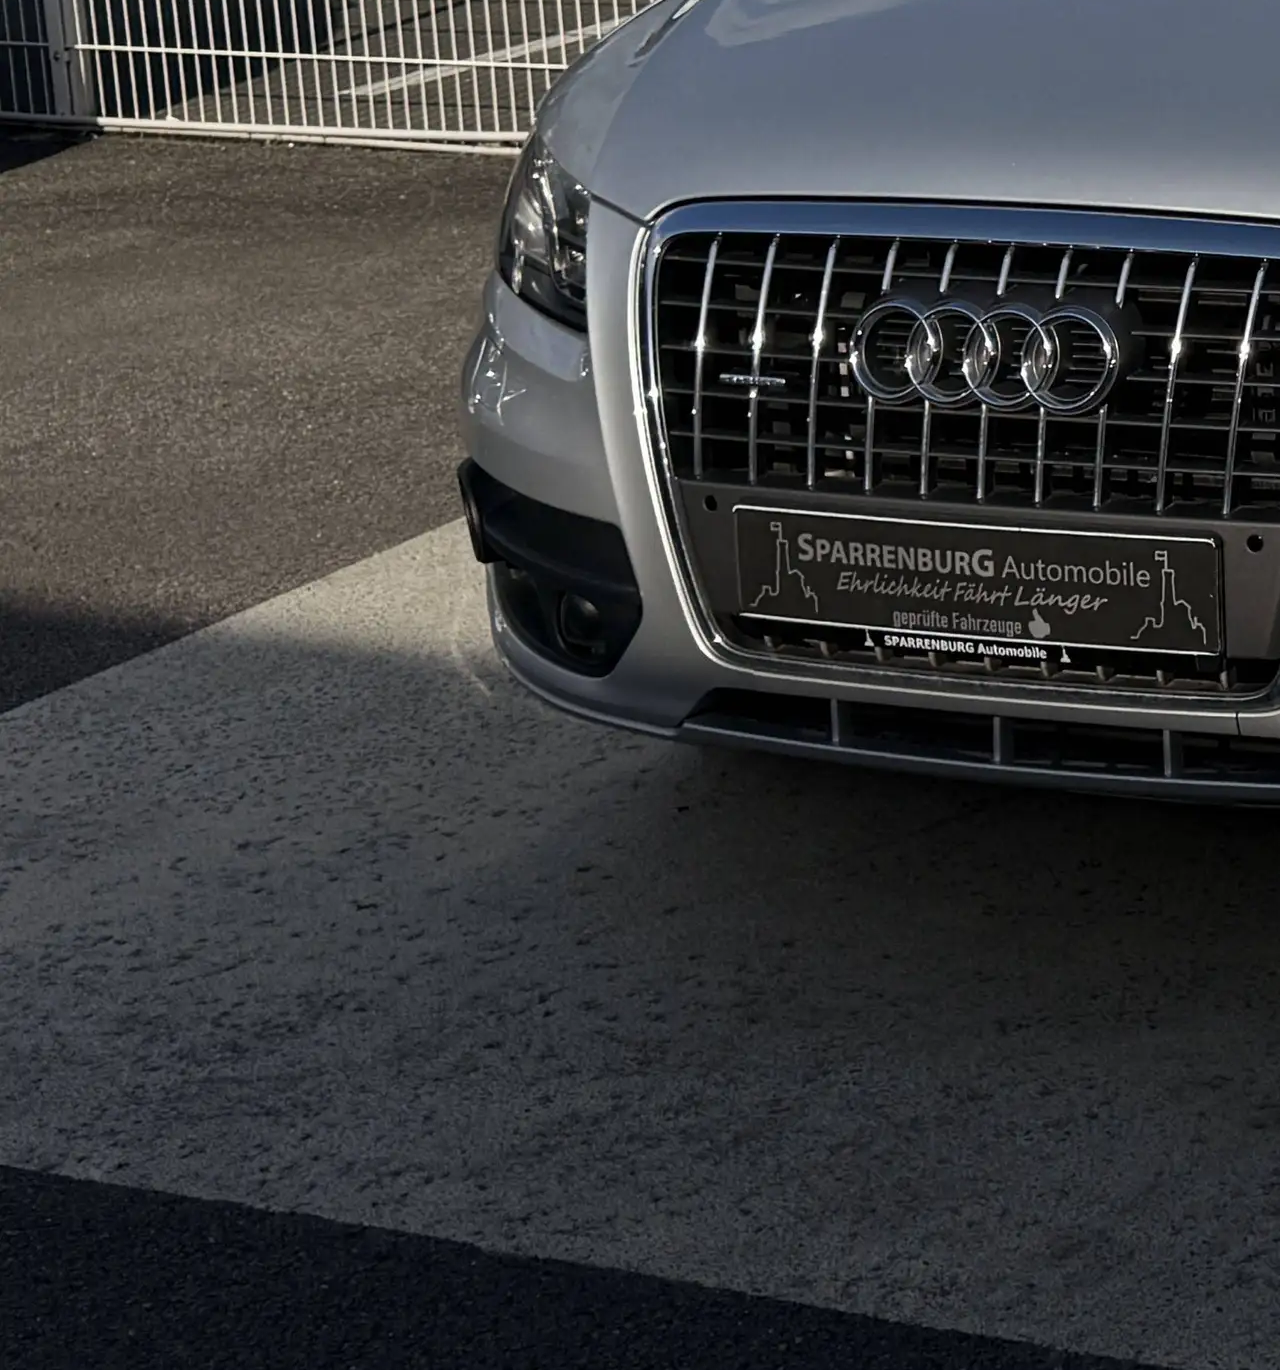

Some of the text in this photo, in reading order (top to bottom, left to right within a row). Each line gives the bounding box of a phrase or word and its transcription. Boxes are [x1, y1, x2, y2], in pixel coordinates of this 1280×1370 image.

[797, 532, 1151, 588] SPARRENBURG Automobile
[837, 571, 1109, 615] Ehrlichkeit Fährt Länger
[893, 609, 1022, 636] geprüfte Fahrzeuge
[884, 634, 1048, 660] SPARRENBURG Automobile
